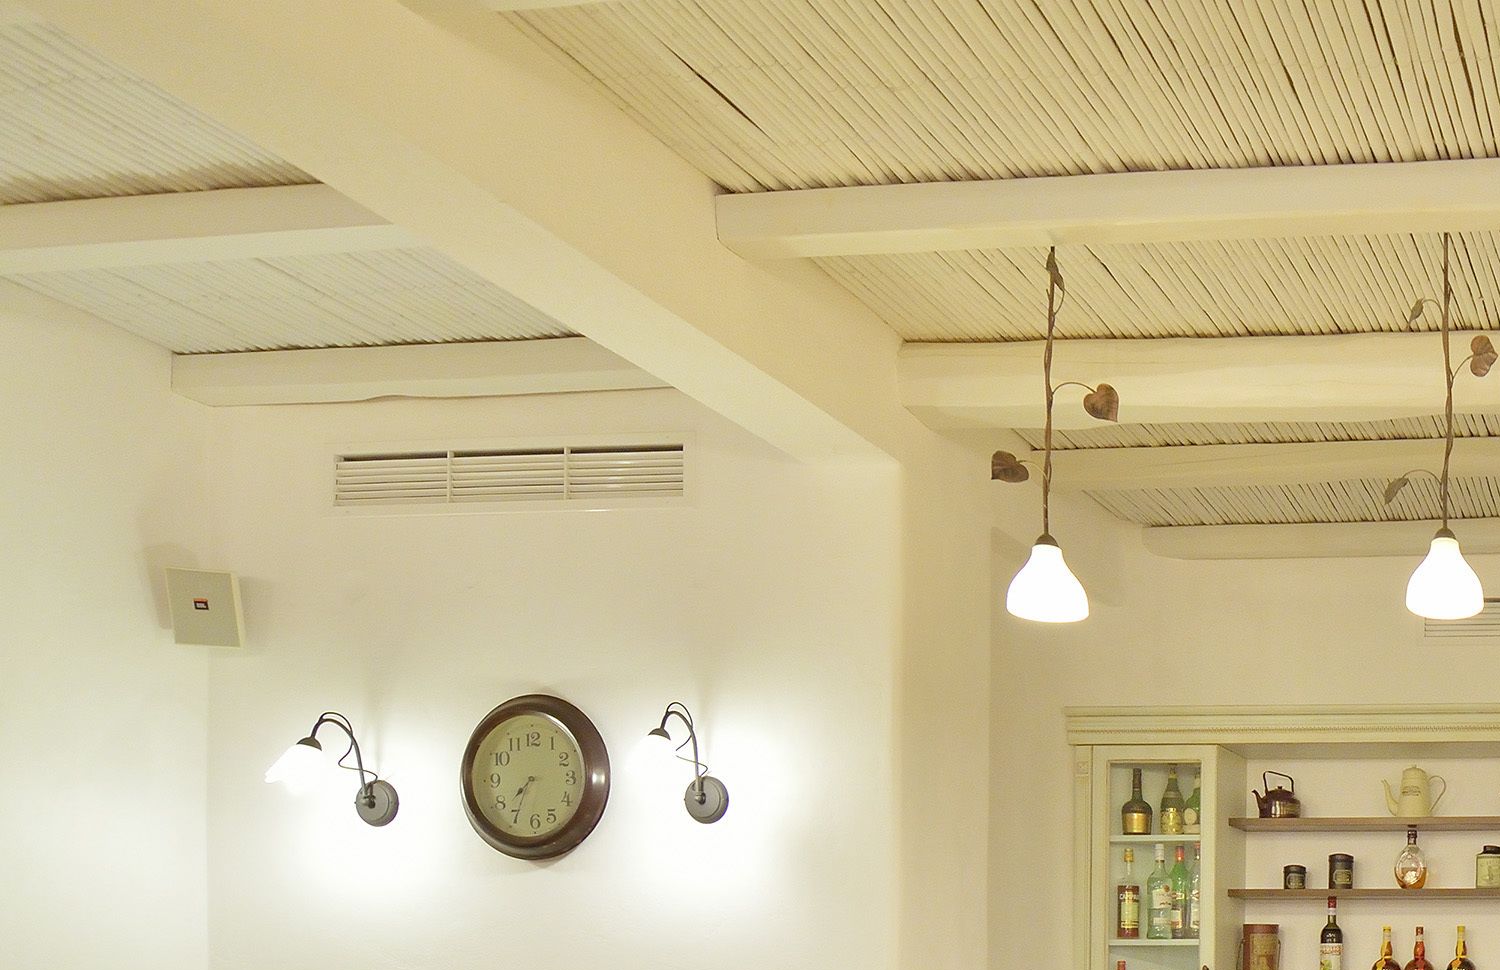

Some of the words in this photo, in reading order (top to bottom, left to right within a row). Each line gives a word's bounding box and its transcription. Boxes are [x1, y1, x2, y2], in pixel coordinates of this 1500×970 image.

[509, 737, 521, 752] 11
[525, 732, 541, 747] 12
[550, 736, 555, 750] 1
[495, 751, 510, 766] 10
[559, 752, 569, 767] 2
[490, 773, 501, 789] 9
[566, 770, 577, 785] 3
[495, 795, 506, 810] 8
[561, 791, 573, 807] 4
[511, 809, 520, 824] 7
[530, 814, 541, 829] 6
[546, 809, 557, 824] 5
